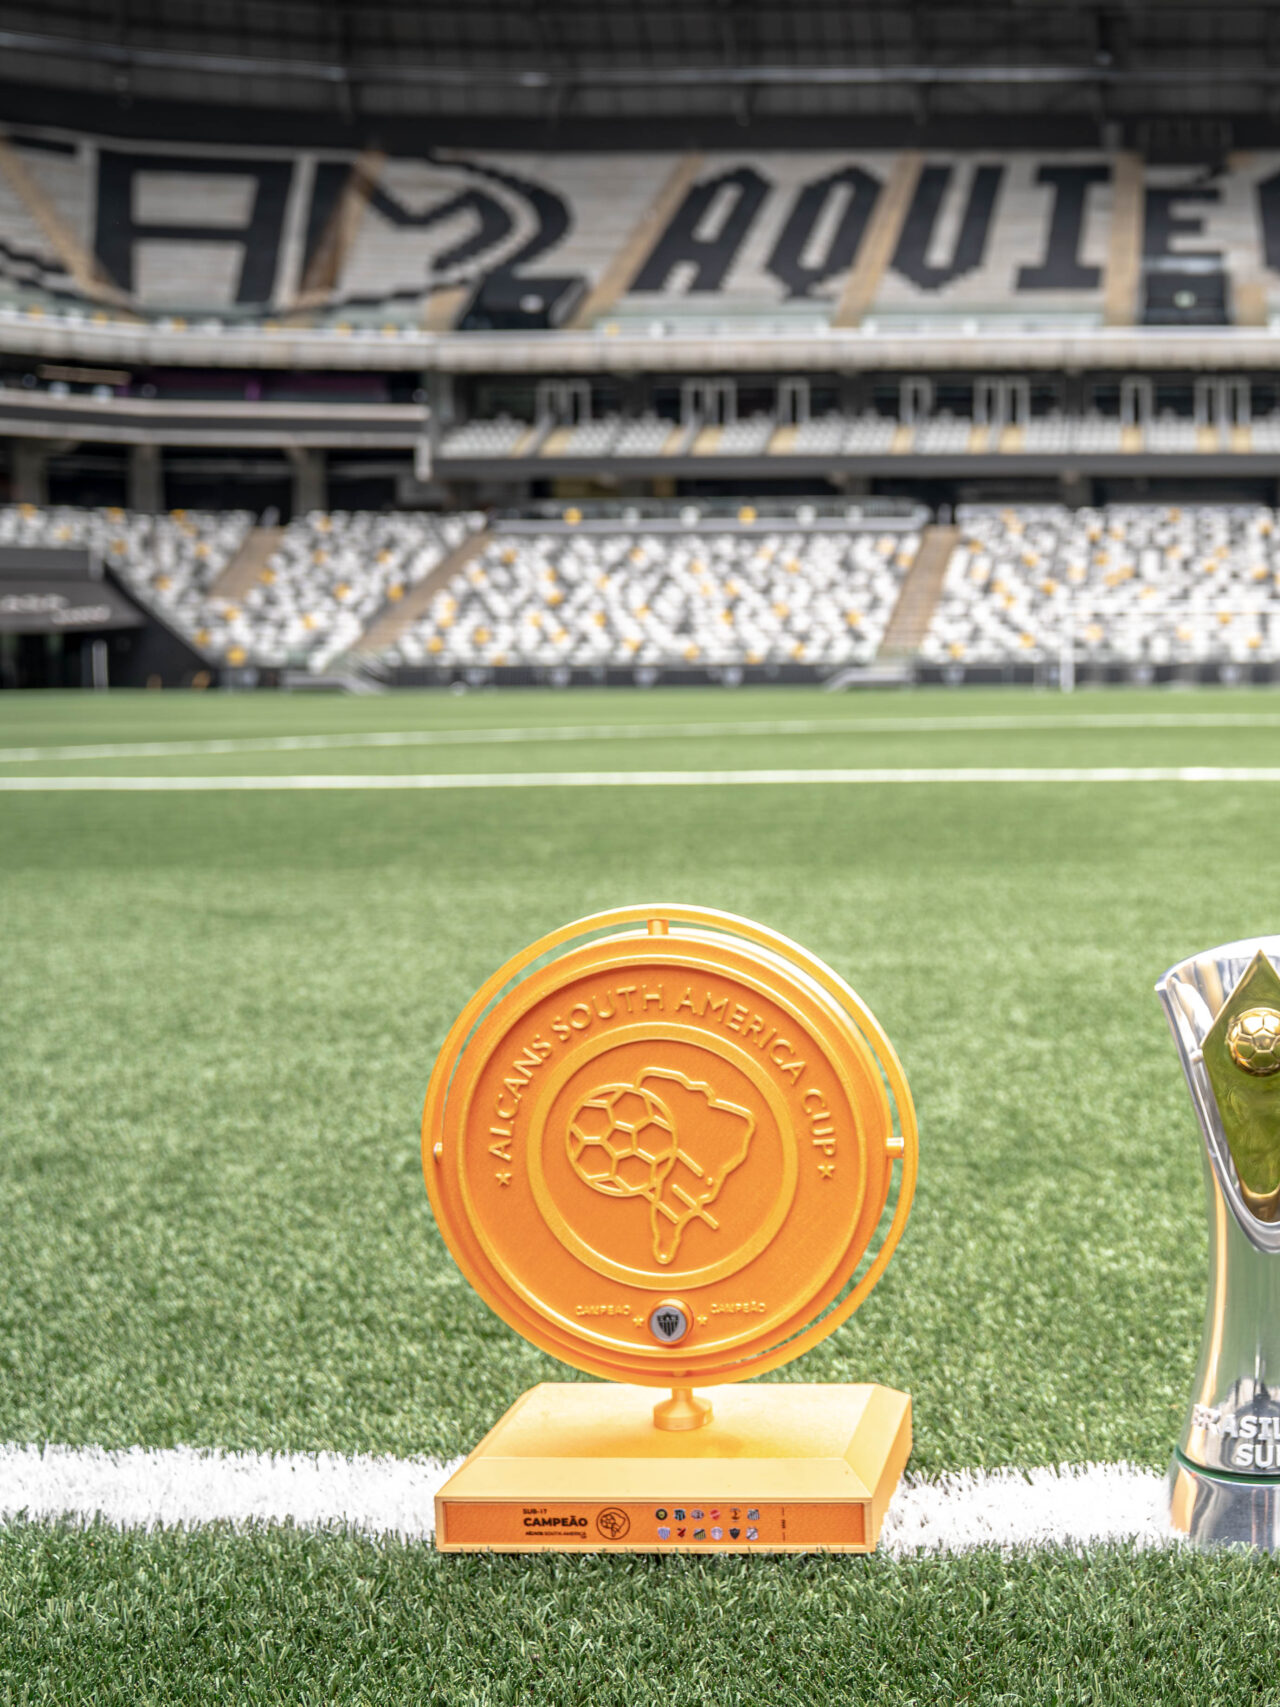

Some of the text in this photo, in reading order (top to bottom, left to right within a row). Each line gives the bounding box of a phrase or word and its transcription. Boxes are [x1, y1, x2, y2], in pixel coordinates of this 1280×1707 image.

[628, 163, 1113, 300] AQUI
[488, 984, 836, 1163] ALCANS SOUTH AMERICA CUP
[523, 1515, 589, 1527] CAMPEÃO
